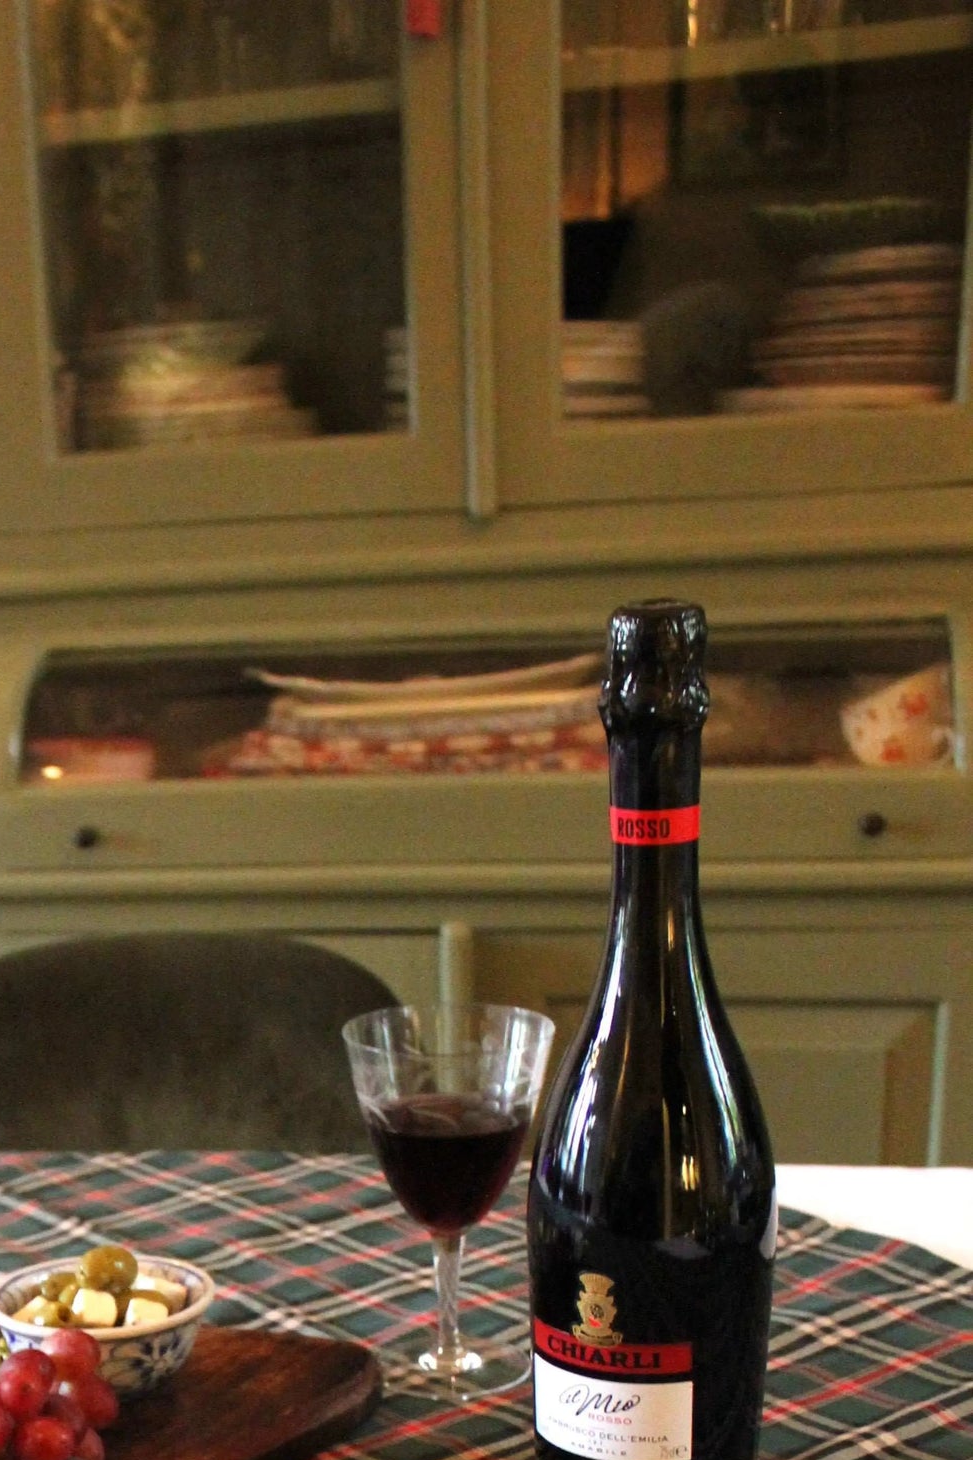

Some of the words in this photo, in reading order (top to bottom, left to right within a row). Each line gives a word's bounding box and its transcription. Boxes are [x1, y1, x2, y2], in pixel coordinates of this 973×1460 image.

[617, 817, 670, 838] ROSSO
[547, 1334, 662, 1369] CHIARLI
[587, 1413, 633, 1426] ROSSO
[599, 1431, 669, 1444] DELL'EMILIA
